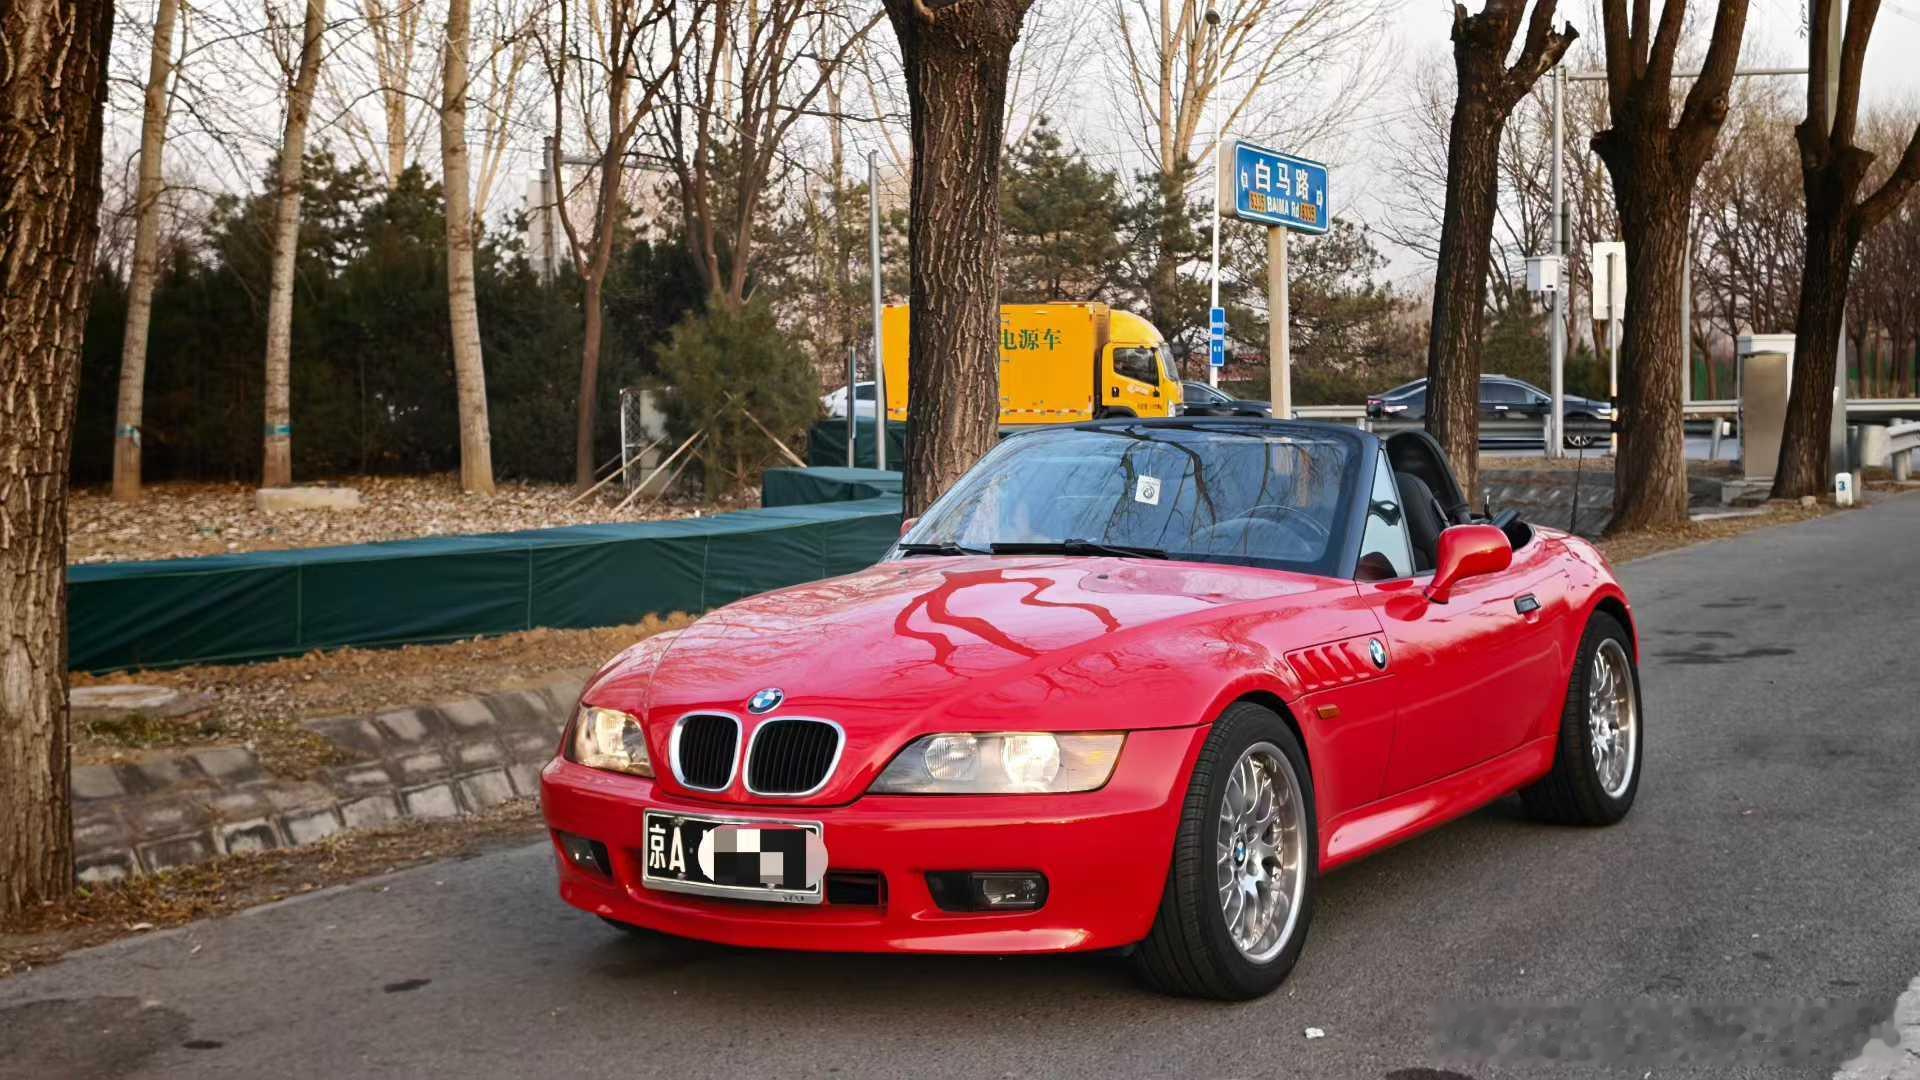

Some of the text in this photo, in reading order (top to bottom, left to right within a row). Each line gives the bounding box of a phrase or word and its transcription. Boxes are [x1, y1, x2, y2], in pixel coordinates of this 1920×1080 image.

[1255, 158, 1309, 201] 白马路
[1266, 195, 1290, 216] BAIMA
[1838, 480, 1846, 492] 3
[649, 824, 686, 873] 京A
